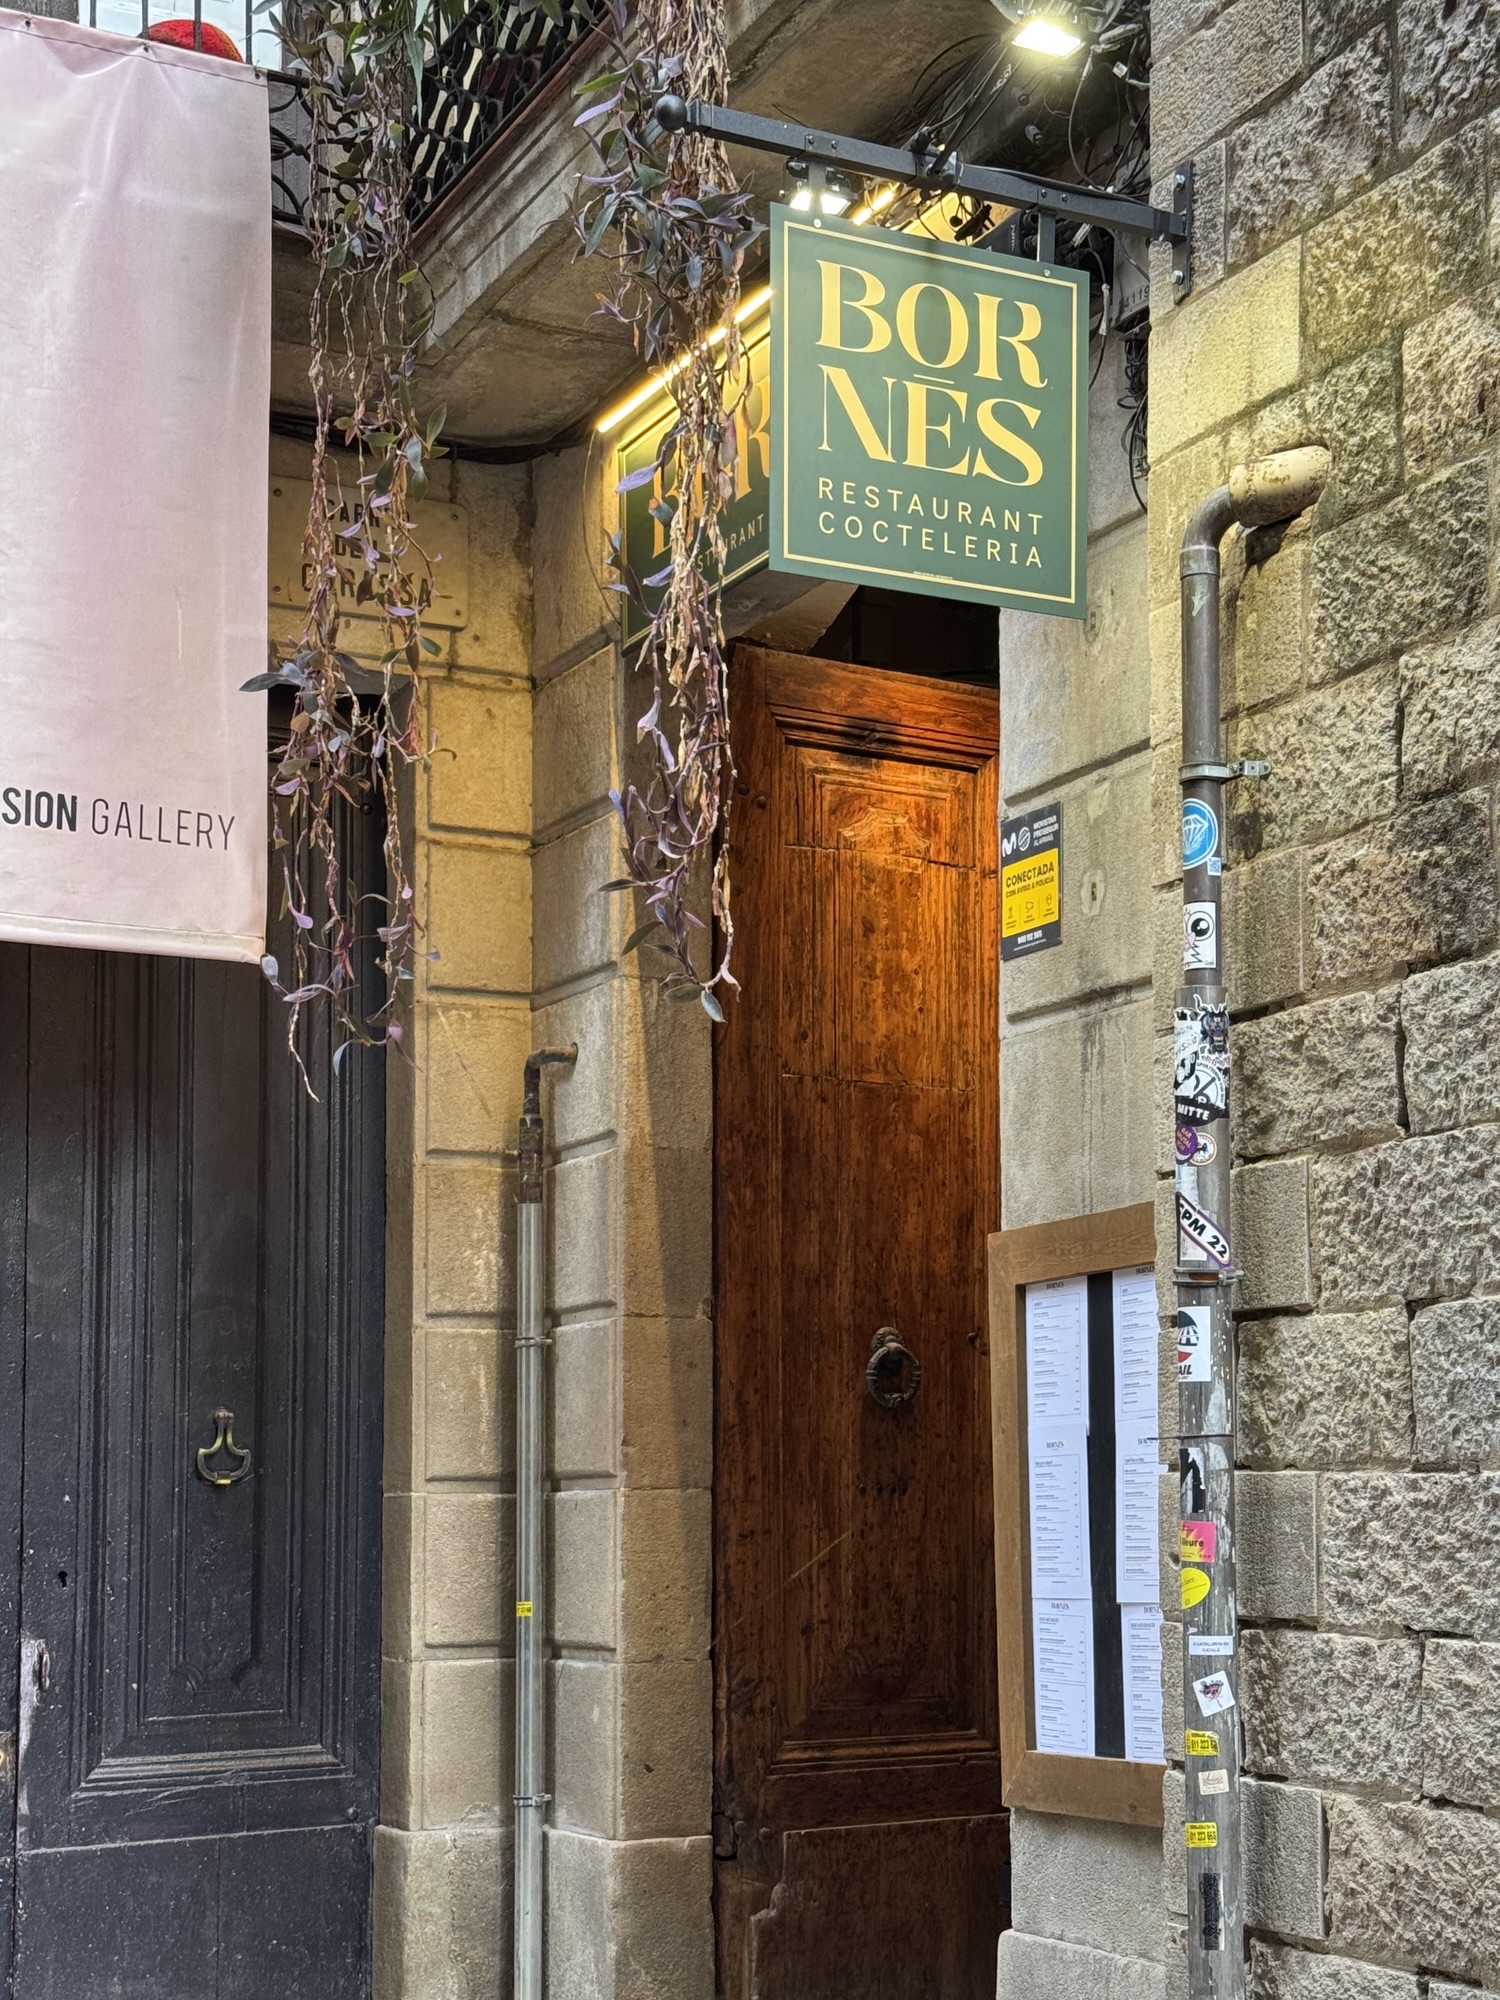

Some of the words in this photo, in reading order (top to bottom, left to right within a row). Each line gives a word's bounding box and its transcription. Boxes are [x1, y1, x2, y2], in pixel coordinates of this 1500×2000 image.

[815, 258, 1048, 389] BOR
[818, 477, 1043, 536] RESTAURANT
[818, 511, 1042, 569] COCTELERIA
[1, 786, 78, 832] SION
[91, 798, 236, 851] GALLERY
[1006, 861, 1055, 888] CONECTADA
[1206, 1234, 1228, 1259] 22
